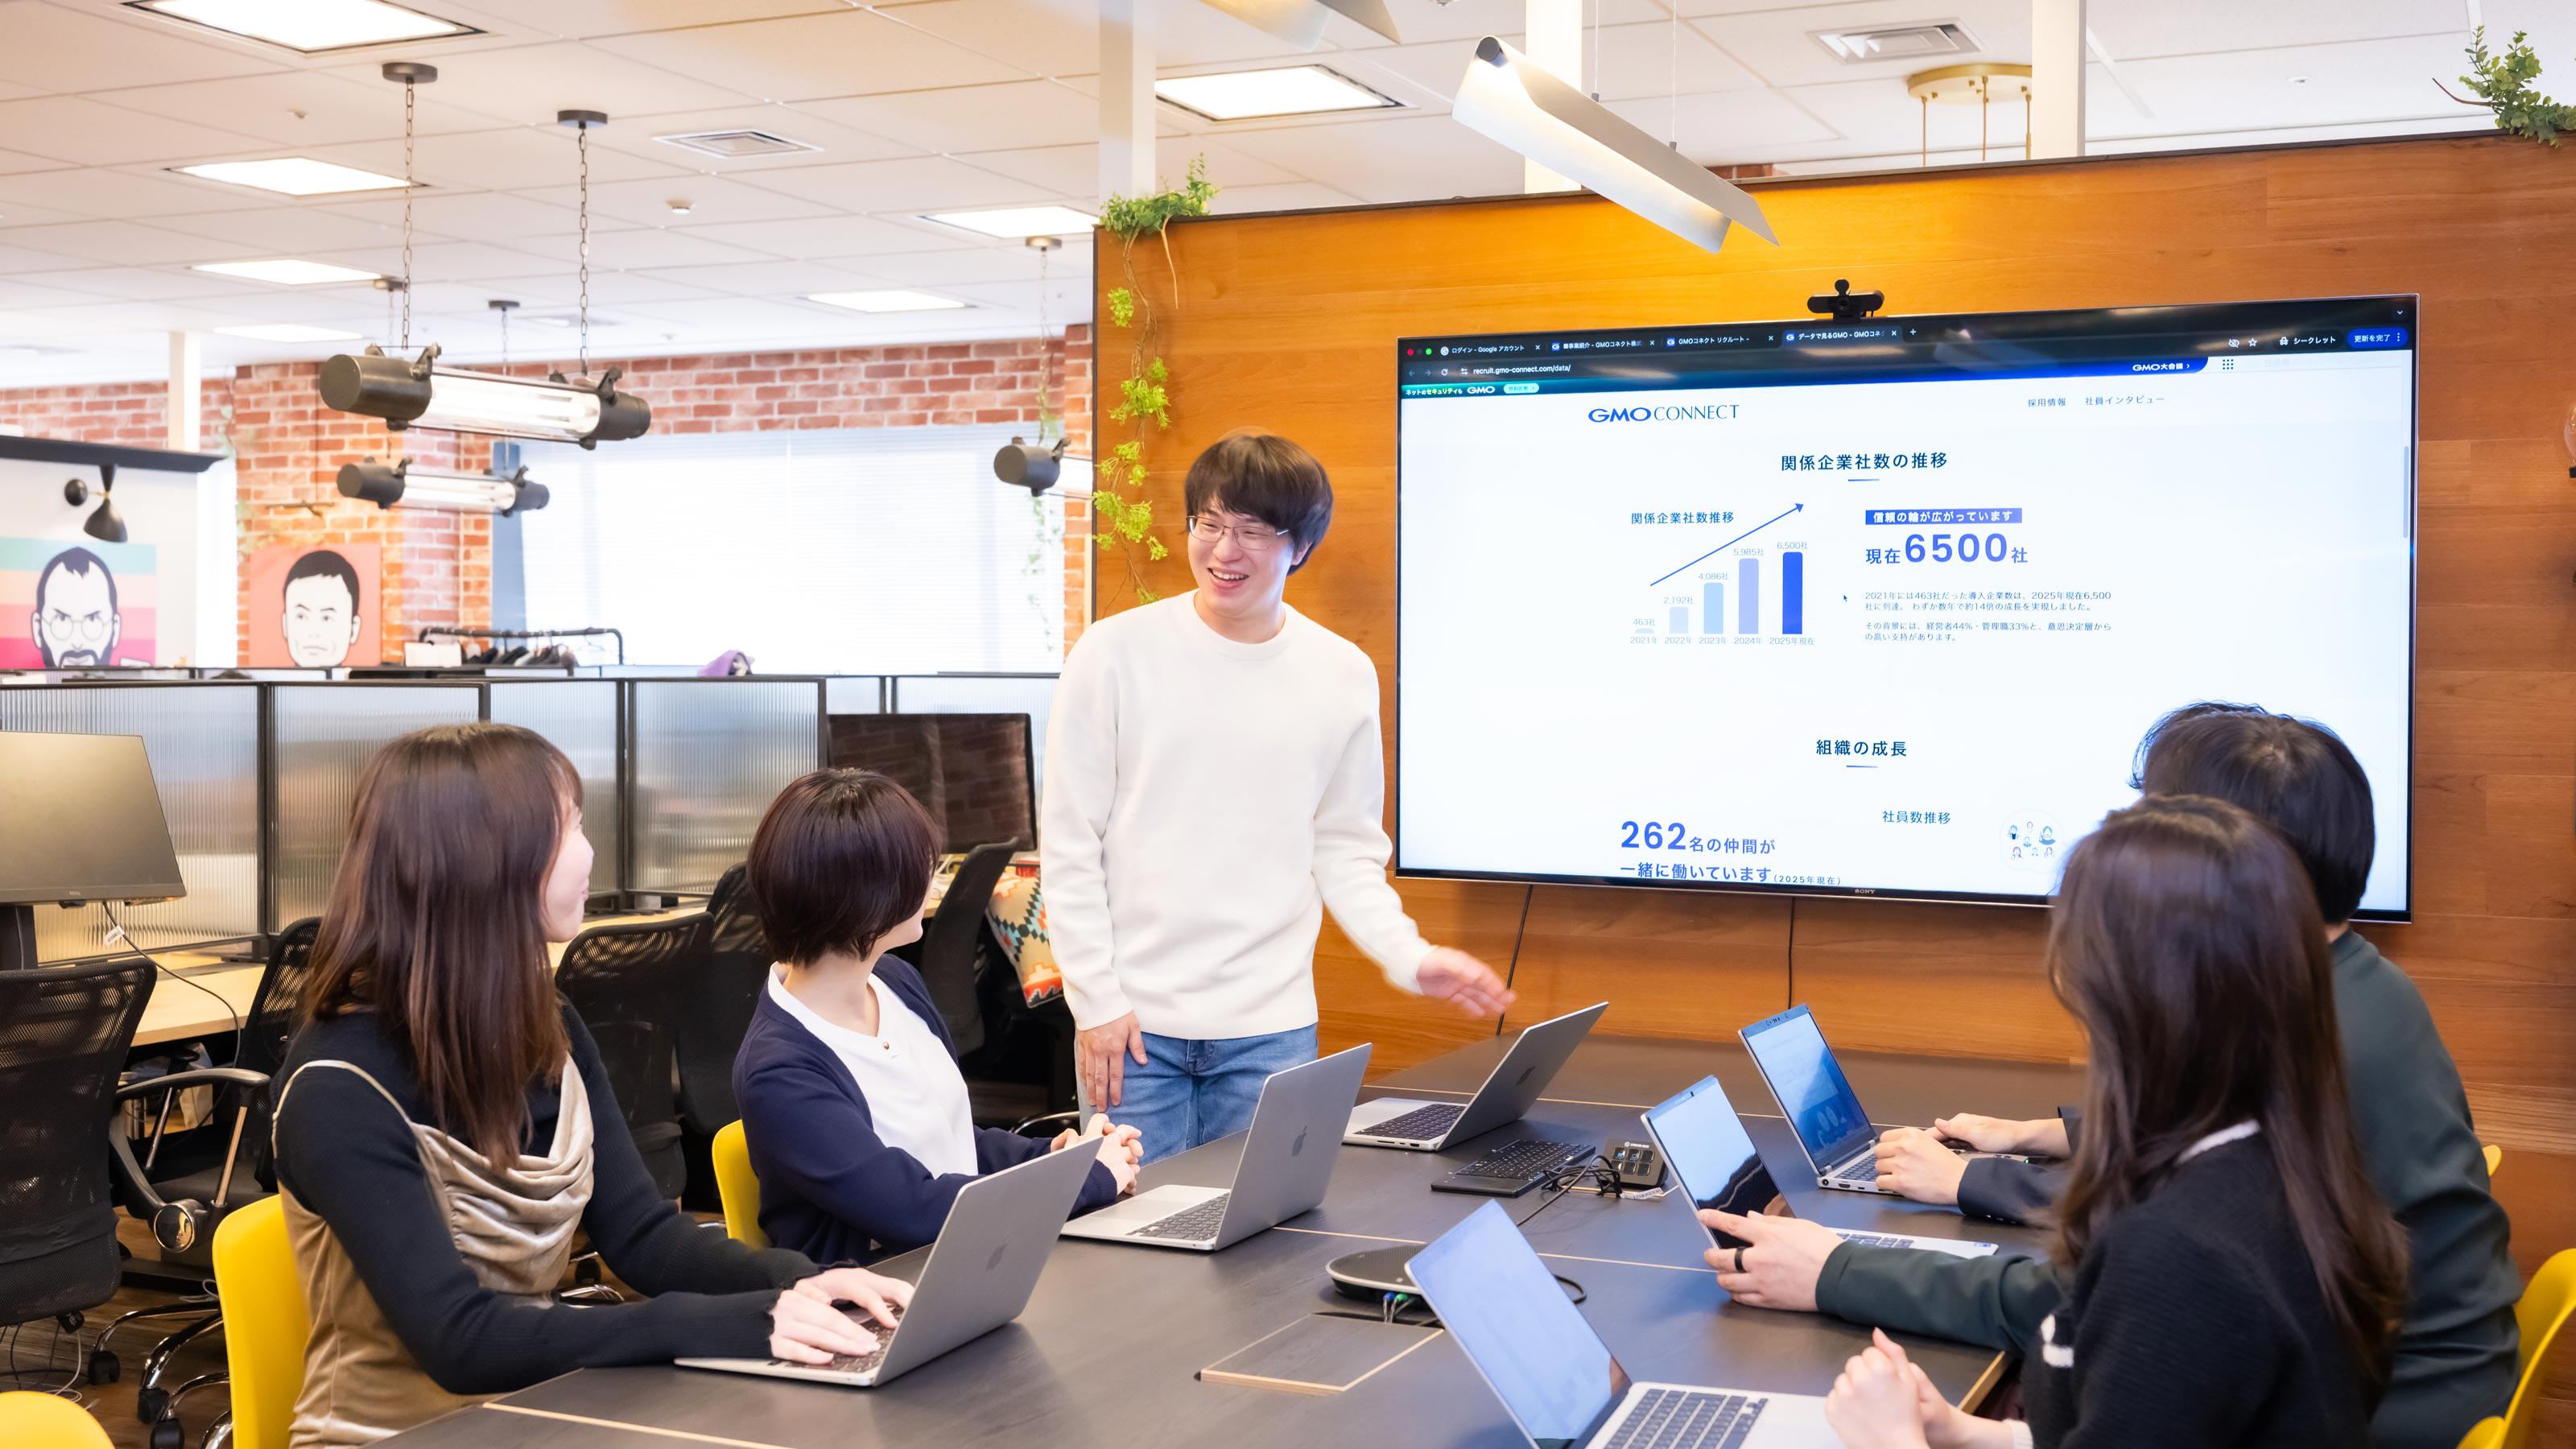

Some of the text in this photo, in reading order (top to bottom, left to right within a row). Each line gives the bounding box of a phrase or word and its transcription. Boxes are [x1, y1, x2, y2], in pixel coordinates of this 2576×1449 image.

[1678, 337, 1715, 345] GMOコネクト
[1716, 336, 1745, 344] リクルート
[1798, 332, 1848, 340] データで見るGMO
[2293, 336, 2336, 345] シークレット
[2354, 333, 2391, 344] 更新を完了
[1473, 365, 1571, 375] recruit.gmo-connect.com/data/
[1467, 386, 1496, 394] GMO
[2028, 397, 2066, 408] 採用情報
[2085, 394, 2165, 407] 社員インタビュー
[1781, 452, 1947, 472] 関係企業社数の推移
[1631, 511, 1734, 525] 関係企業社数推移
[1873, 510, 2013, 523] 信頼の輪が広がっています
[1777, 541, 1808, 550] 6,500社
[1733, 548, 1764, 556] 5,985社
[1699, 572, 1729, 580] 4,086社
[1664, 597, 1694, 605] 2,192社
[1633, 618, 1656, 626] 463社
[1630, 636, 1658, 645] 2021年
[1665, 636, 1691, 645] 2022年
[1699, 636, 1727, 645] 2023年
[1734, 636, 1762, 645] 2024年
[1769, 636, 1815, 646] 2025年現在
[1865, 633, 1958, 642] の高い支持があります。
[1816, 739, 1907, 758] 組織の成長
[1882, 810, 1951, 825] 社員数推移
